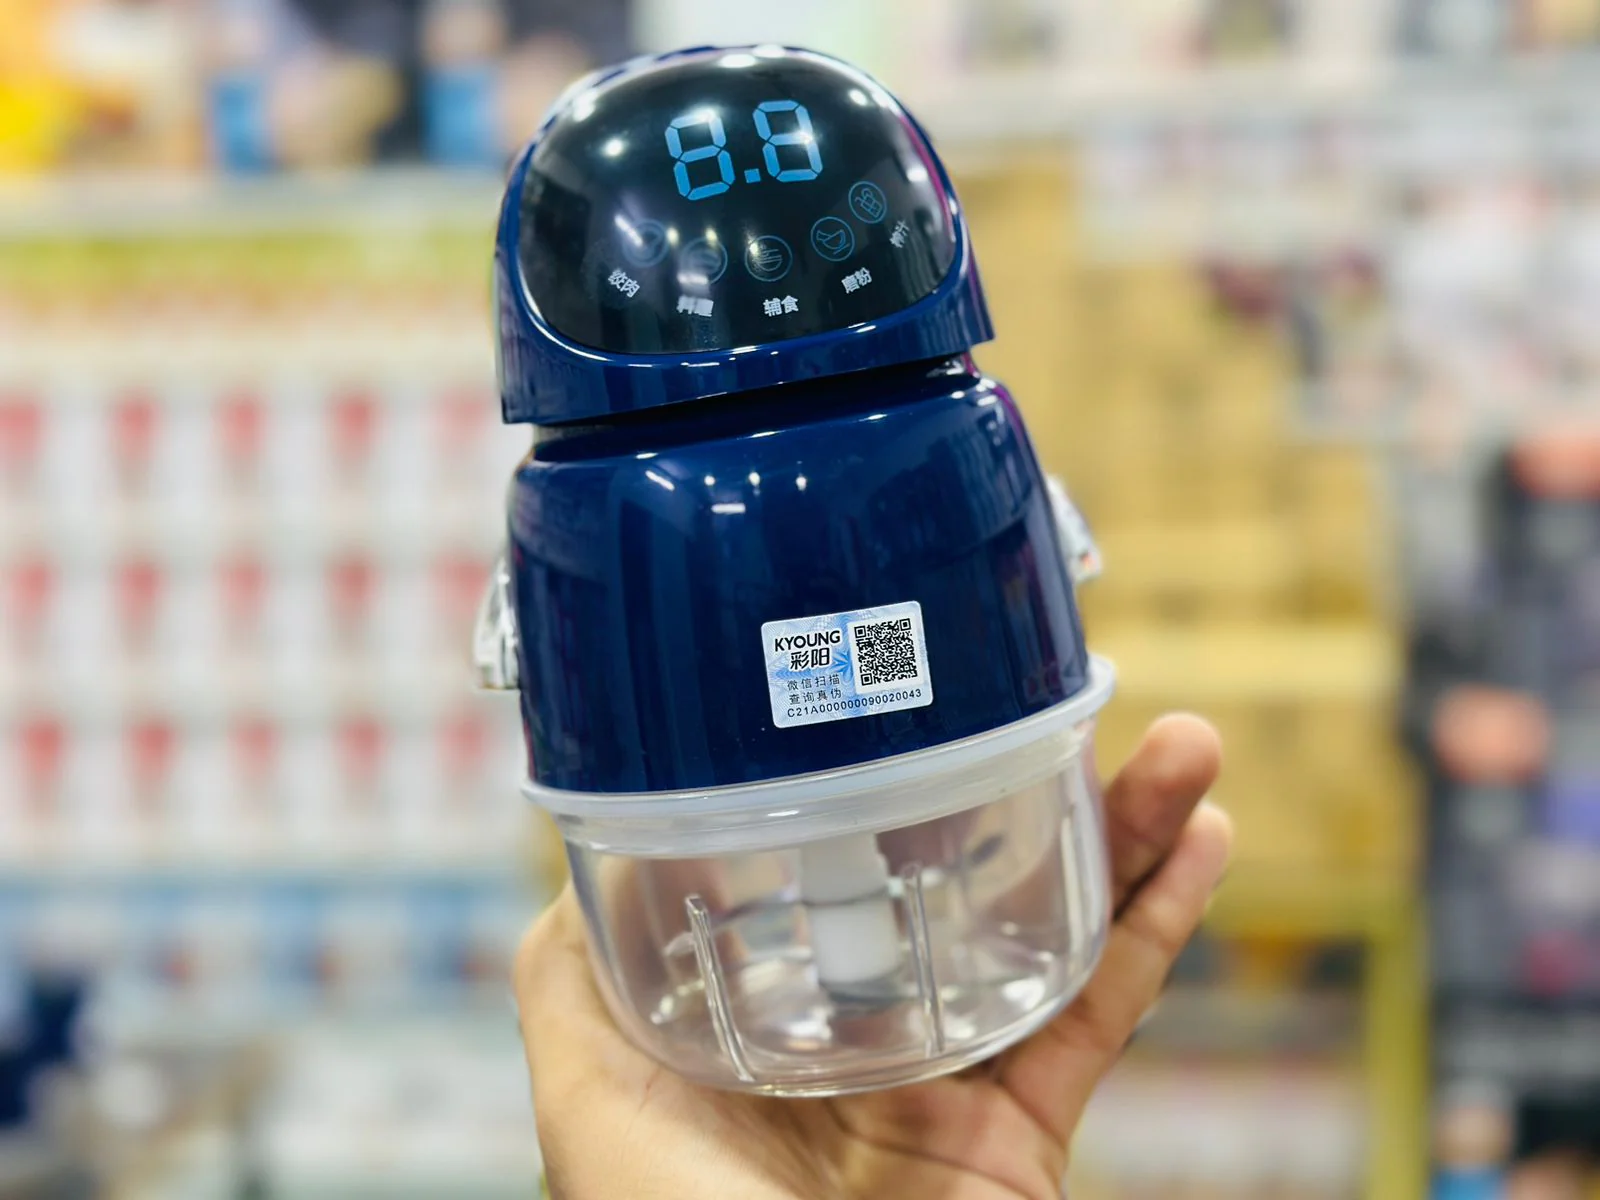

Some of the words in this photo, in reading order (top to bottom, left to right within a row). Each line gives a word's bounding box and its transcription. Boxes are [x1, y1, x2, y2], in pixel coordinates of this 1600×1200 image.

[665, 100, 823, 201] 8.8
[608, 268, 640, 298] 绞肉
[841, 267, 872, 294] 磨粉
[763, 295, 799, 317] 辅食
[775, 630, 841, 652] KYOUNG
[790, 648, 830, 670] 彩阳
[787, 674, 840, 691] 微信扫描
[787, 688, 922, 718] C21A000000090020043
[789, 688, 842, 705] 查询真伪
